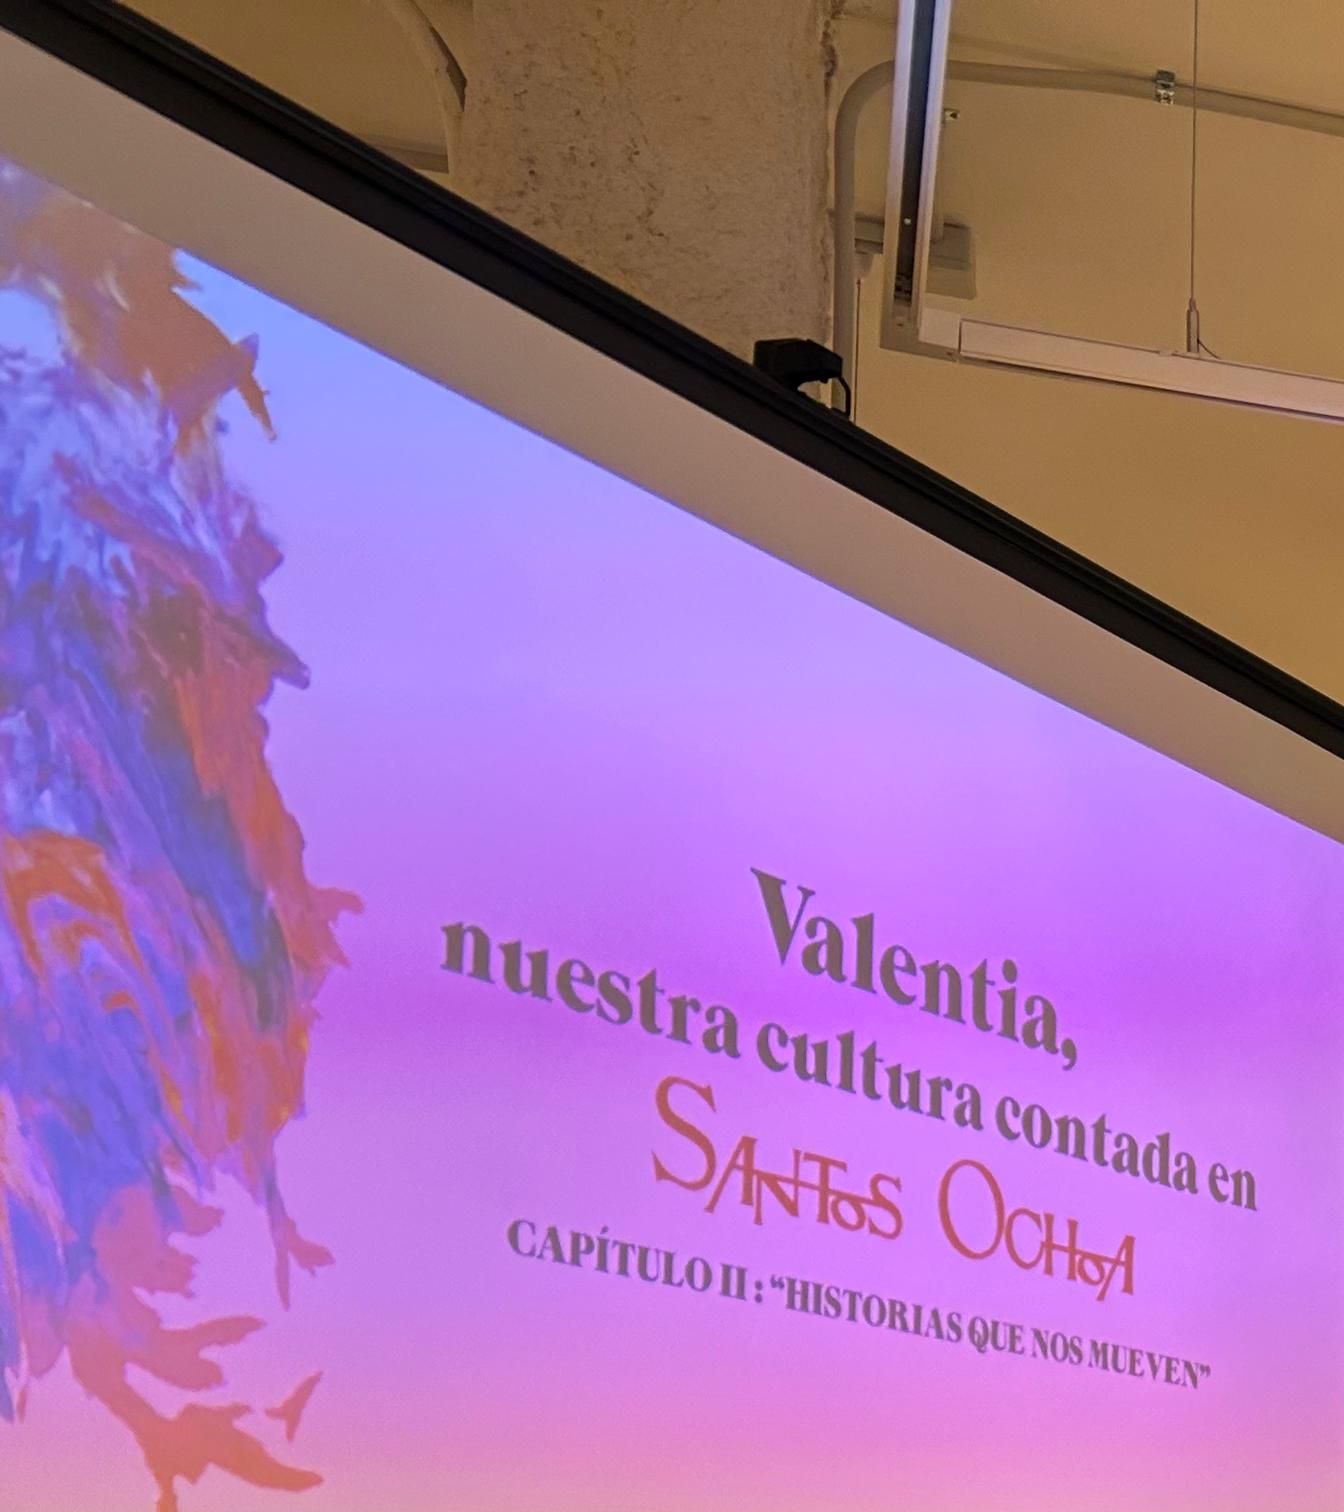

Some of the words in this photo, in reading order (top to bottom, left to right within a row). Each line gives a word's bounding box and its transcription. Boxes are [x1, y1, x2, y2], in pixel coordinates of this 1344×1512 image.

[440, 918, 742, 1060] nuestra
[756, 1021, 984, 1131] cultura
[994, 1098, 1199, 1198] contada
[1207, 1163, 1259, 1211] en
[750, 867, 1077, 1070] Valentia,
[506, 1218, 713, 1293] CAPÍTULO
[967, 1315, 1026, 1357] QUE
[1030, 1326, 1084, 1367] NOS
